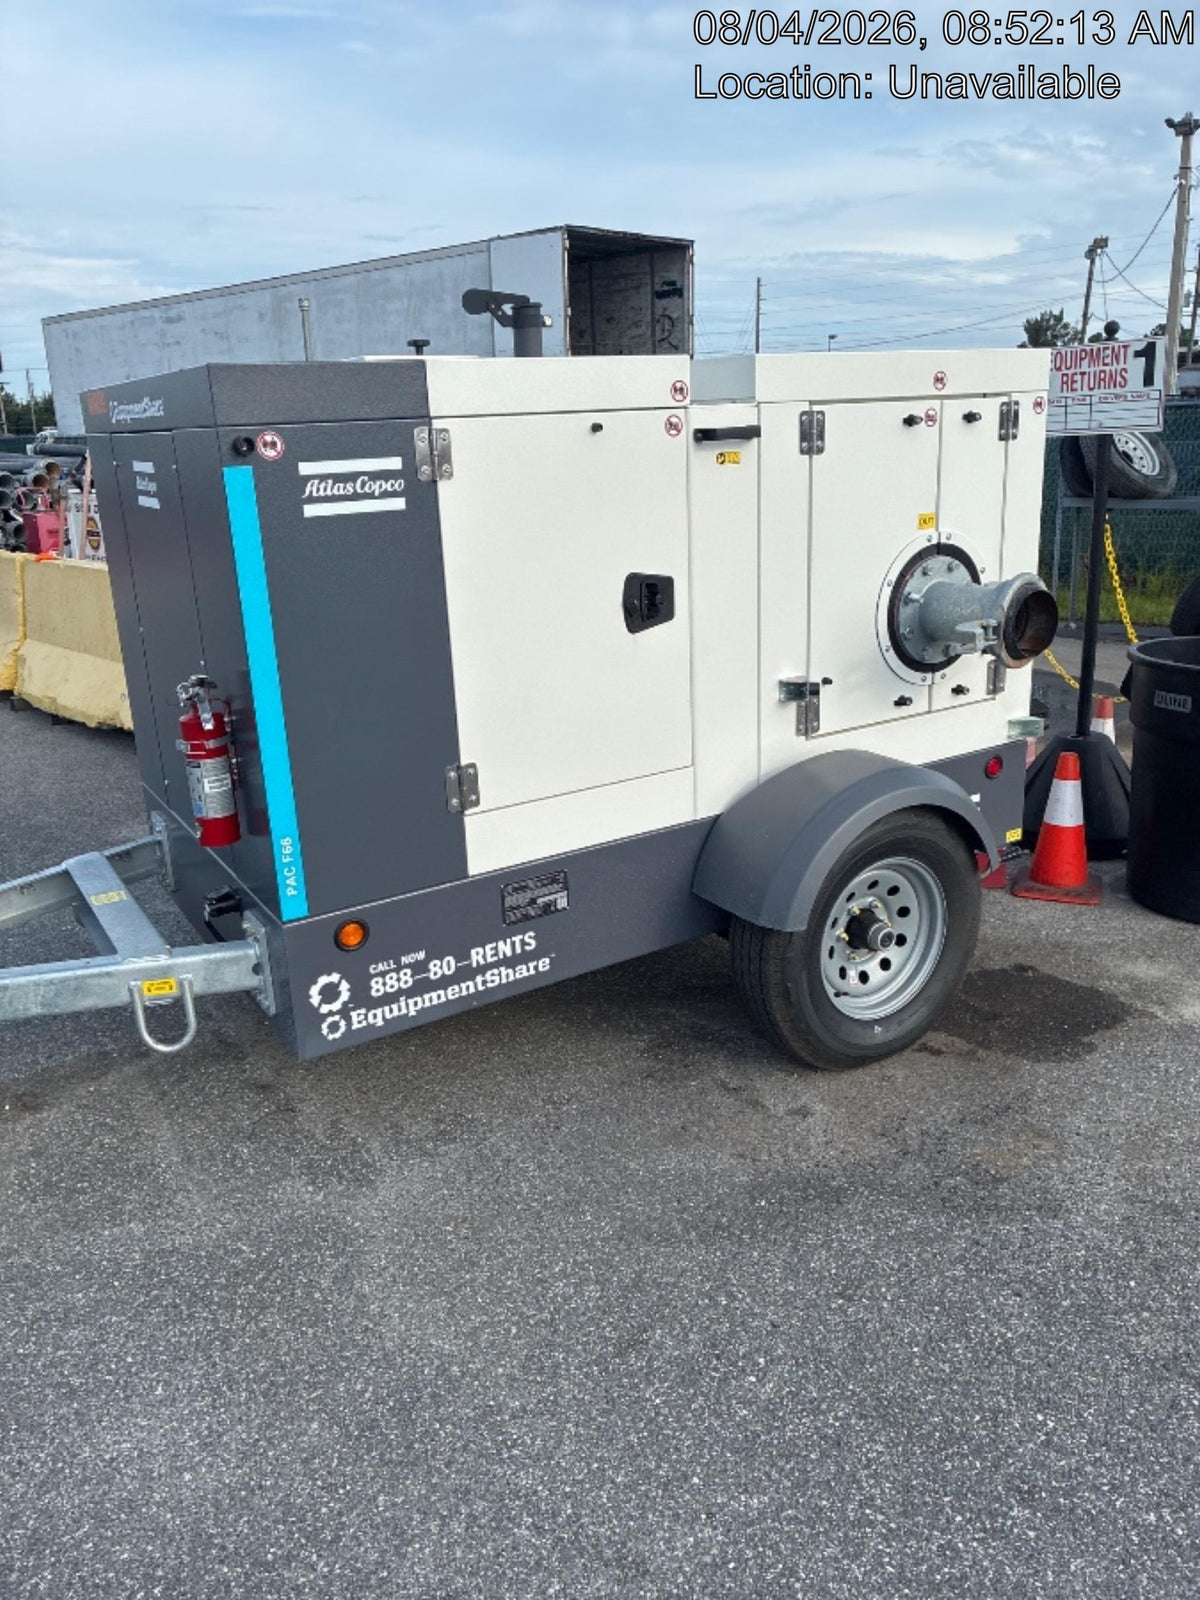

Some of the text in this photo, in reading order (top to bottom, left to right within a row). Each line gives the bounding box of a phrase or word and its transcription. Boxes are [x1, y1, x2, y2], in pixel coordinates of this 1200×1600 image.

[1133, 340, 1157, 388] 1
[1060, 367, 1128, 393] RETURNS
[301, 475, 405, 498] Atlas Copco
[283, 865, 298, 896] PAC
[368, 949, 426, 975] CALL NOW
[350, 956, 552, 1030] EquipmentShare
